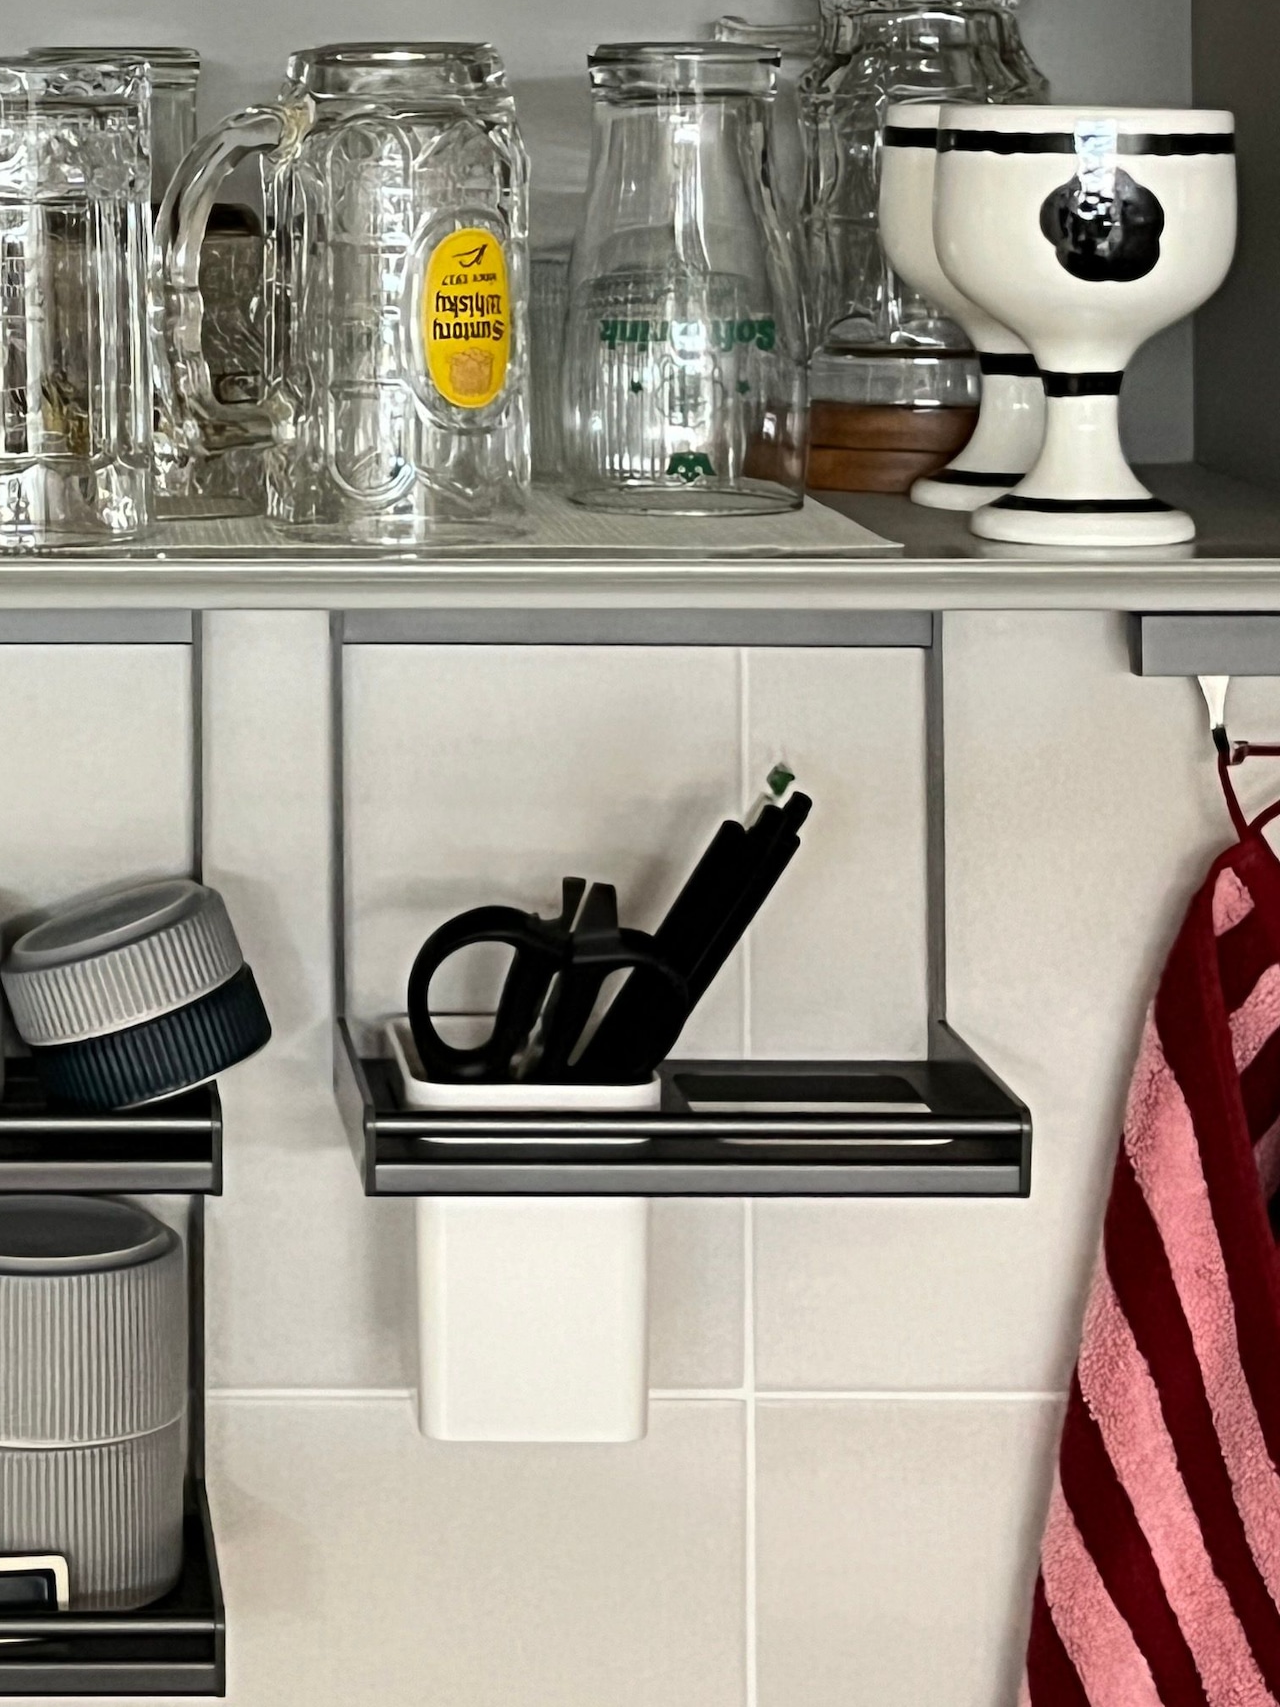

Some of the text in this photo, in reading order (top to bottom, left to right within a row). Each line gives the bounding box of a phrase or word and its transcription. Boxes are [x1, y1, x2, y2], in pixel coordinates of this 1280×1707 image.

[434, 290, 502, 319] Whisky
[432, 318, 505, 342] Suntory
[600, 320, 685, 353] rink
